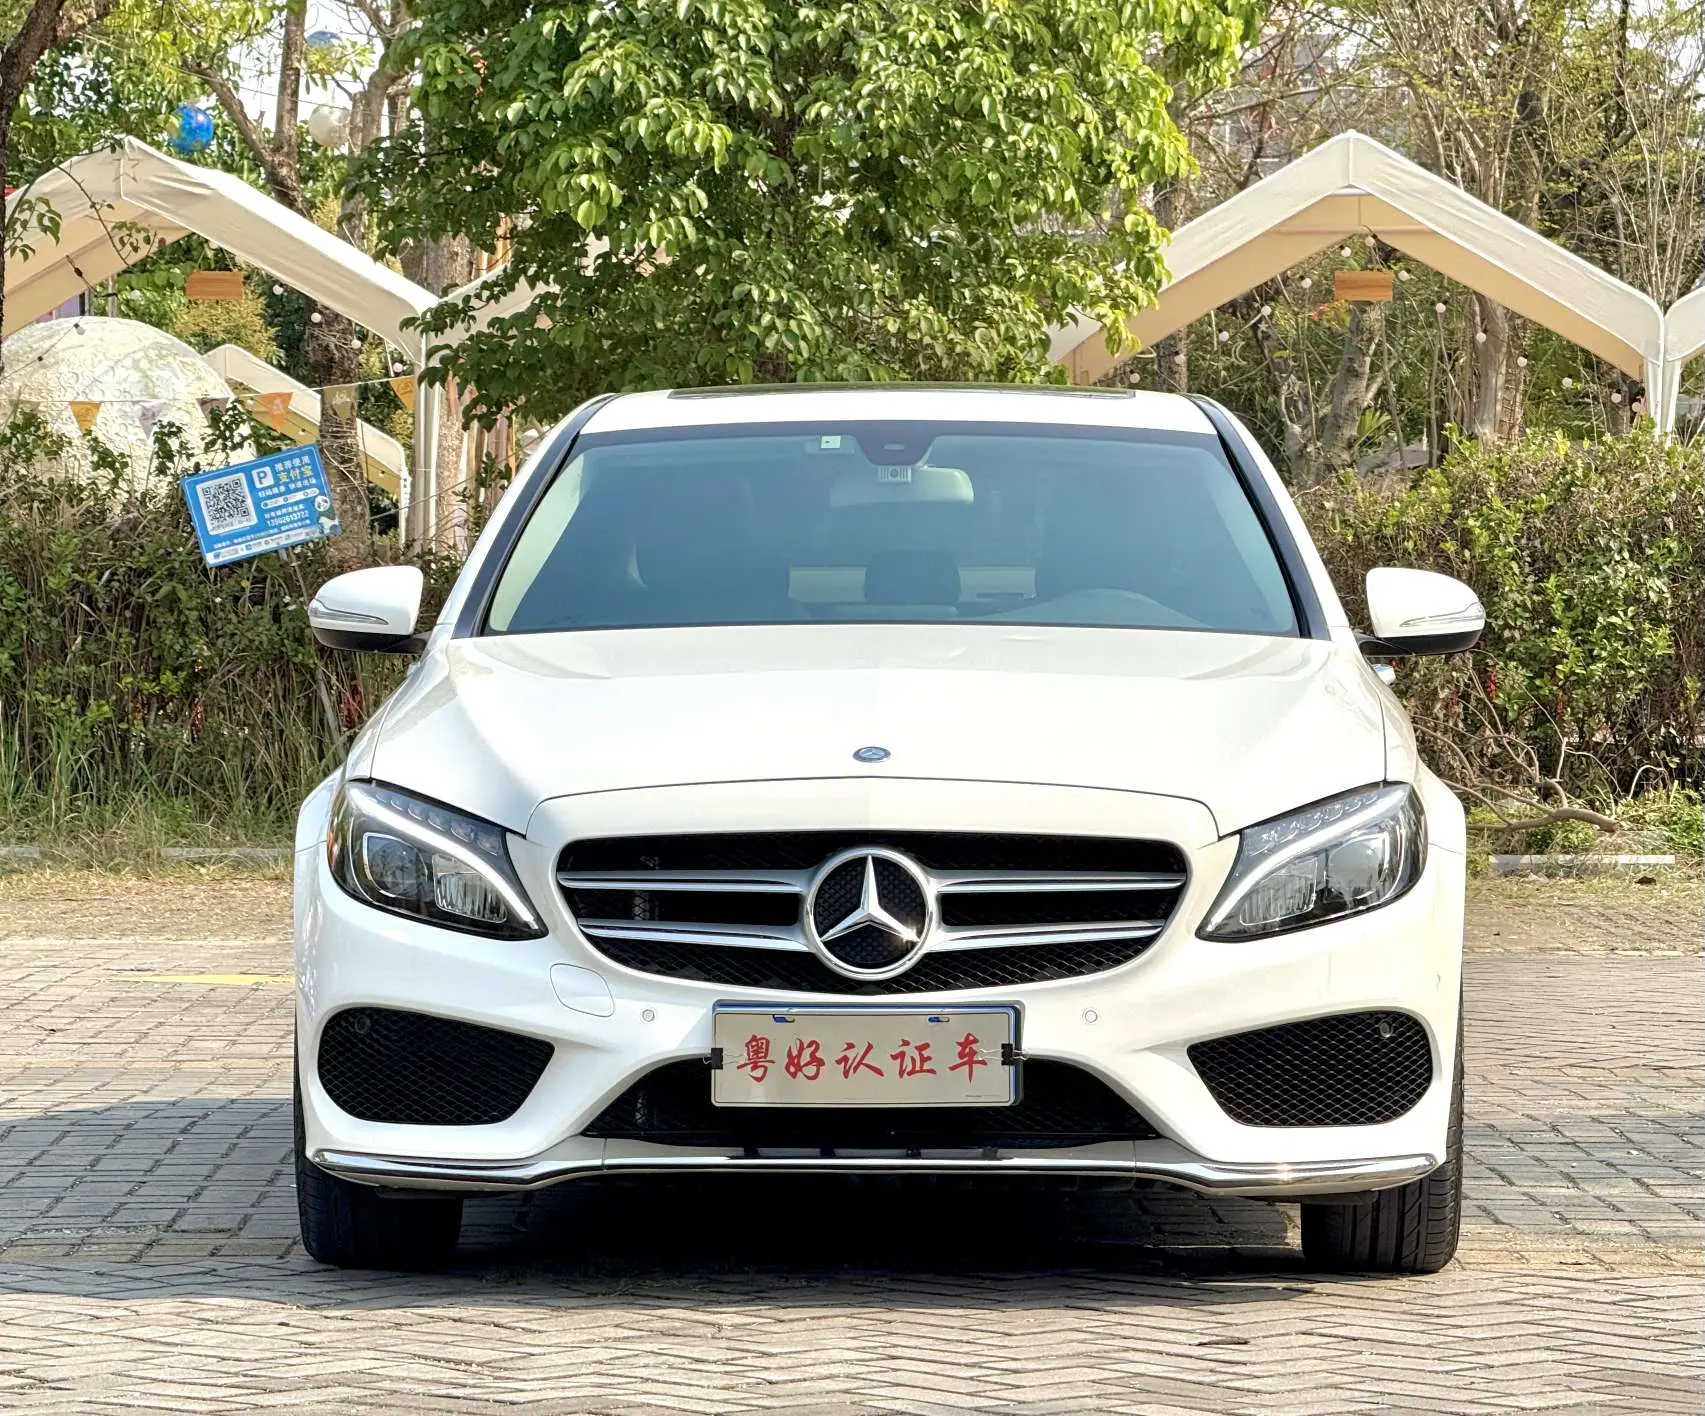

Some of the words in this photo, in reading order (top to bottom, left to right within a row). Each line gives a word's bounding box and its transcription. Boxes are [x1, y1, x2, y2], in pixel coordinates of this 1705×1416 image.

[256, 470, 267, 485] P
[277, 465, 313, 483] 支付宝
[736, 1032, 988, 1083] 粤好认证车
